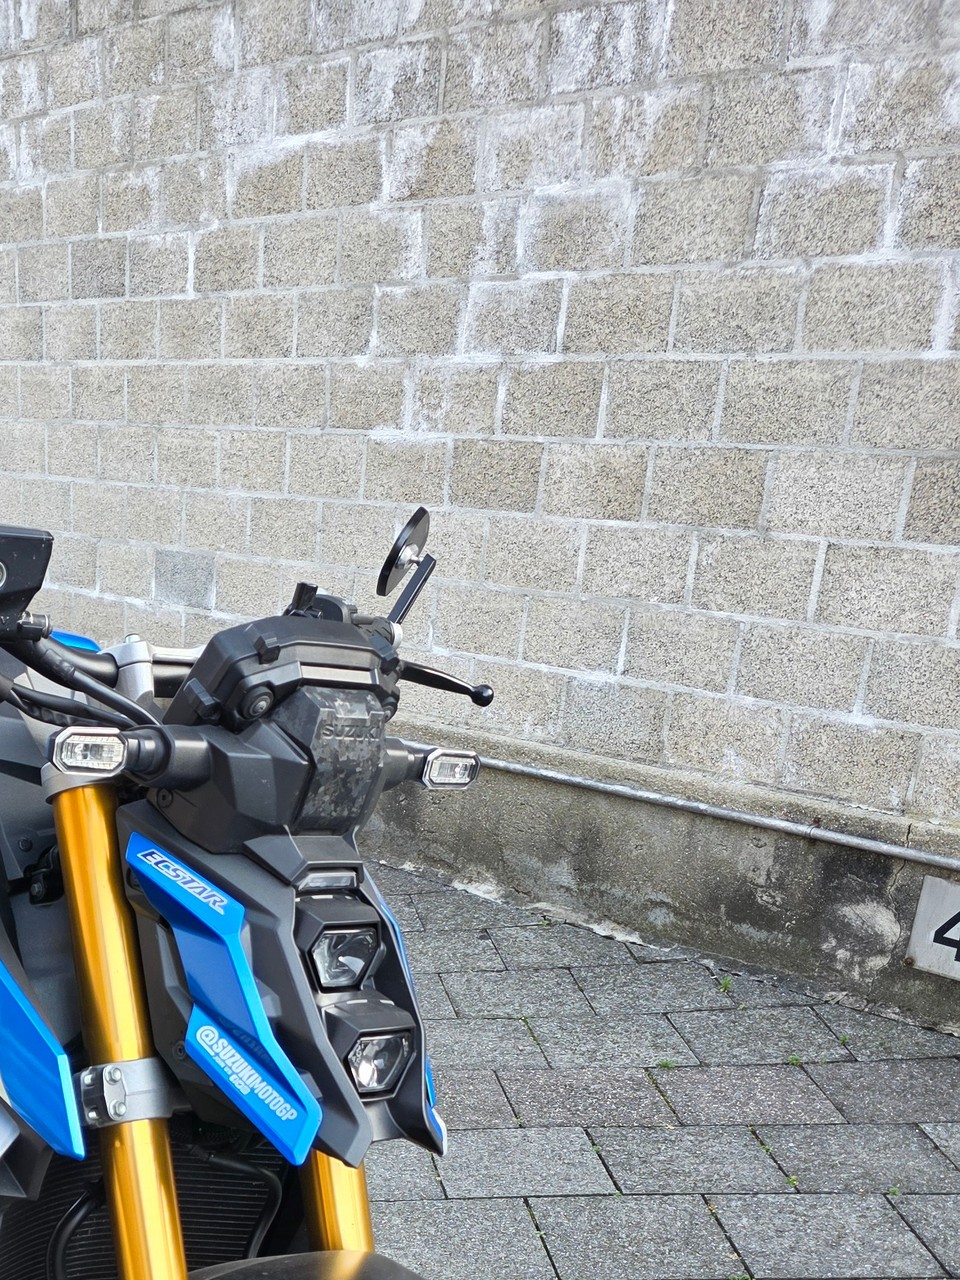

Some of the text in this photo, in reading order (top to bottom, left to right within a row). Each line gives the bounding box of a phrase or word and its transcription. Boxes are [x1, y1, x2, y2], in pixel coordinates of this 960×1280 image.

[321, 725, 382, 741] SUZUKI
[137, 849, 228, 915] ECSTAR
[196, 1025, 298, 1121] @SUZUKIMOTOGP
